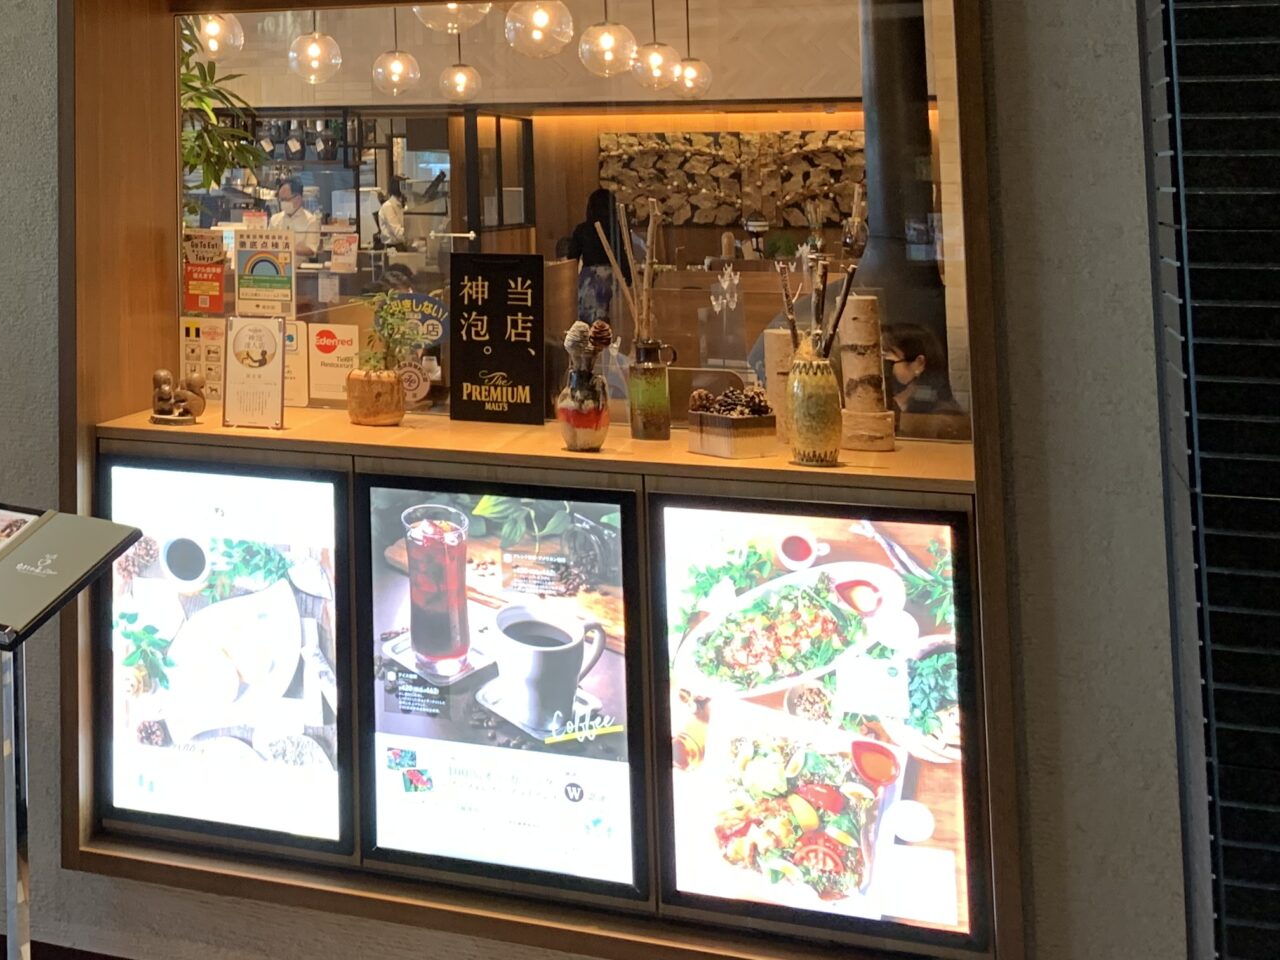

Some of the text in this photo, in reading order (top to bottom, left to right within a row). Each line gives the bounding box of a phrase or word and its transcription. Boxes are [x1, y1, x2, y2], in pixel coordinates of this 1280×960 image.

[381, 299, 448, 321] 引きしない!
[459, 275, 493, 355] 神泡。
[505, 276, 536, 356] 当店、
[315, 336, 353, 346] Edenred
[479, 370, 513, 386] The
[462, 382, 531, 404] PREMIUM
[551, 710, 616, 743] Coffee
